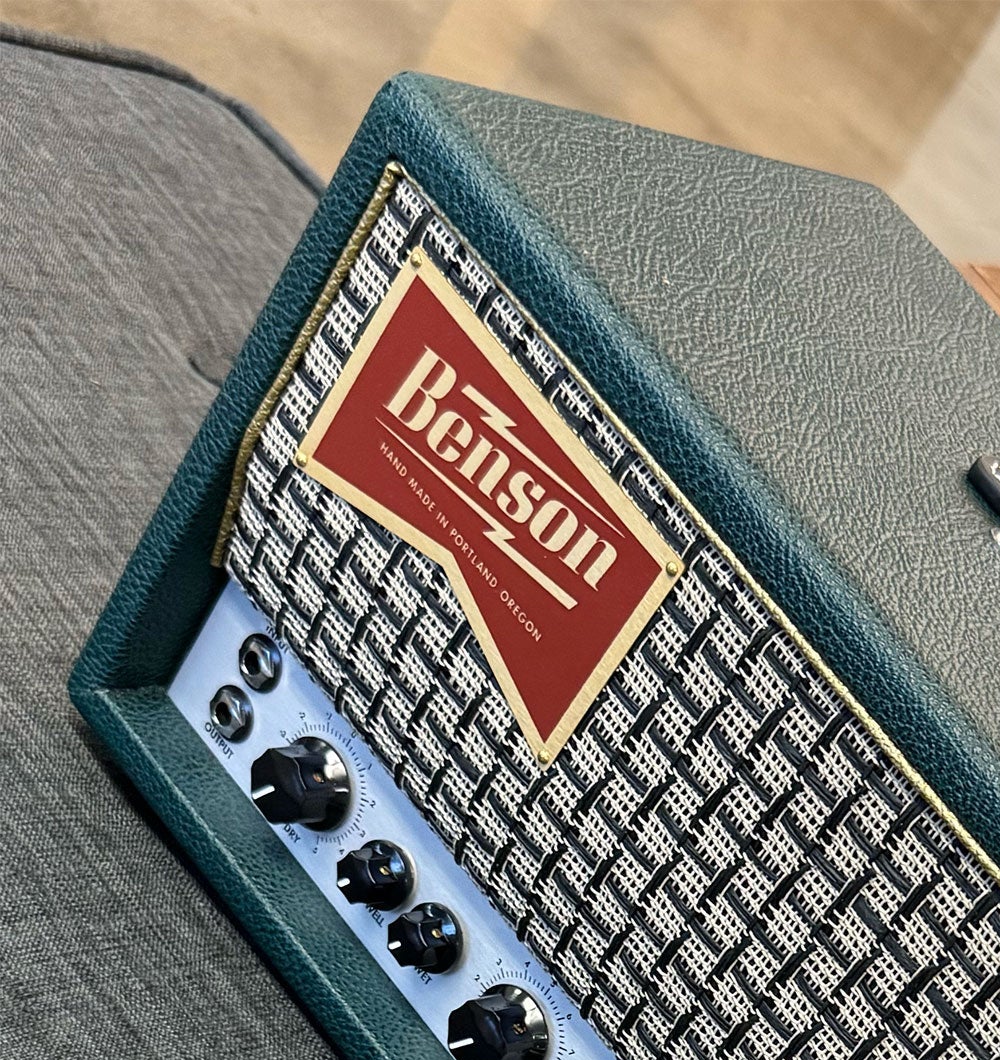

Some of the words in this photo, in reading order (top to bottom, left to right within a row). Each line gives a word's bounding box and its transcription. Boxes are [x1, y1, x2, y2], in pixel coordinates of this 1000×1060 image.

[382, 345, 620, 591] Benson
[380, 442, 408, 477] HAND
[408, 478, 436, 512] MADE
[436, 511, 449, 529] IN
[450, 527, 499, 588] PORTLAND
[500, 590, 542, 642] OREGON
[204, 721, 235, 760] OUTPUT
[283, 822, 302, 843] DRY
[366, 903, 387, 929] WELL
